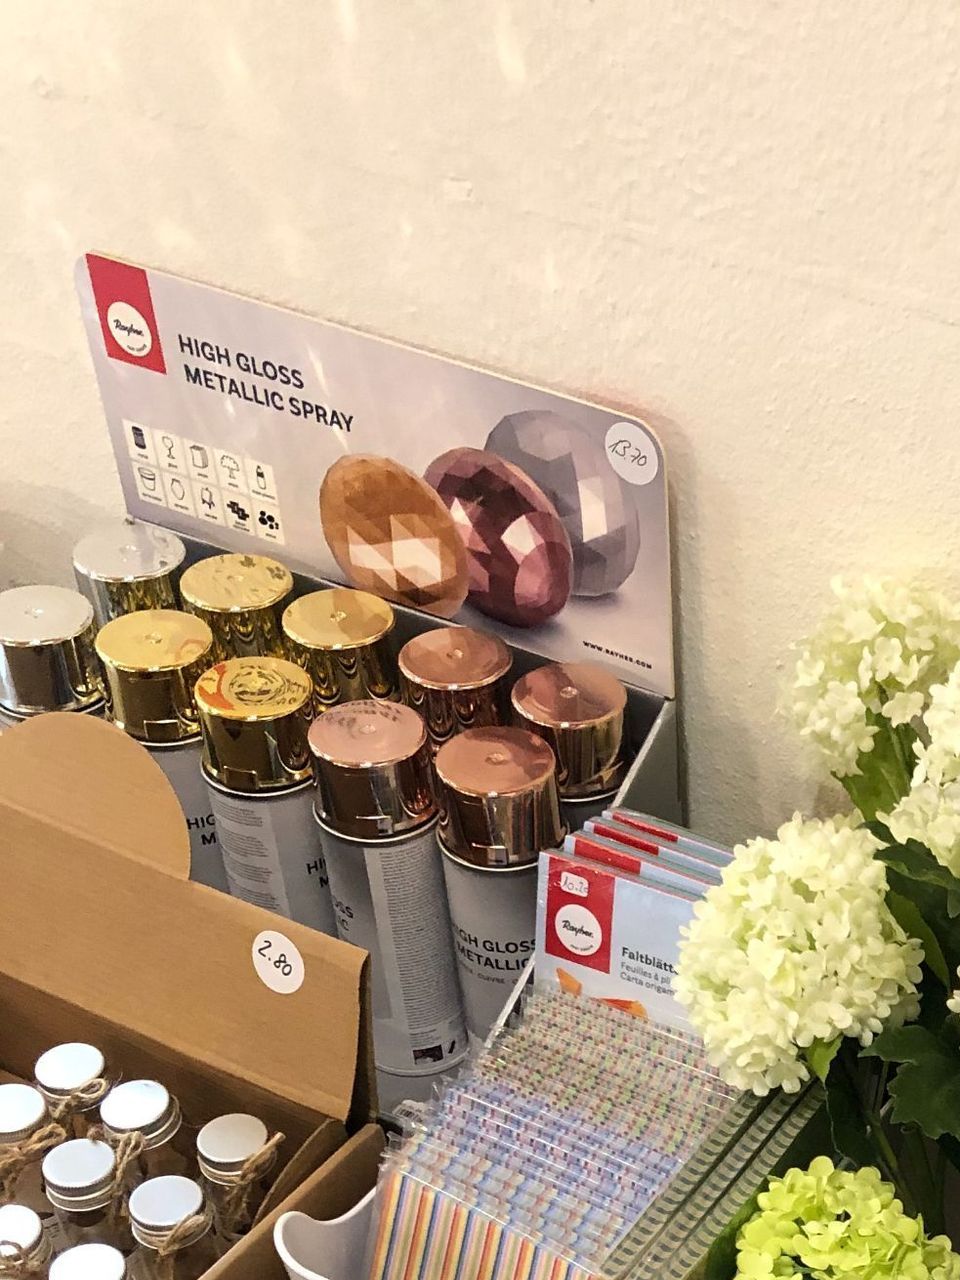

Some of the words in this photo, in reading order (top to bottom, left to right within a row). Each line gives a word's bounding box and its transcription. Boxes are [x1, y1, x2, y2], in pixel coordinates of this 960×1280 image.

[178, 334, 231, 367] HIGH
[235, 352, 305, 390] GLOSS
[183, 364, 284, 411] METALLIC
[288, 397, 354, 432] SPRAY
[258, 940, 293, 977] 2.80
[620, 971, 644, 986] Carta
[645, 981, 678, 996] origam
